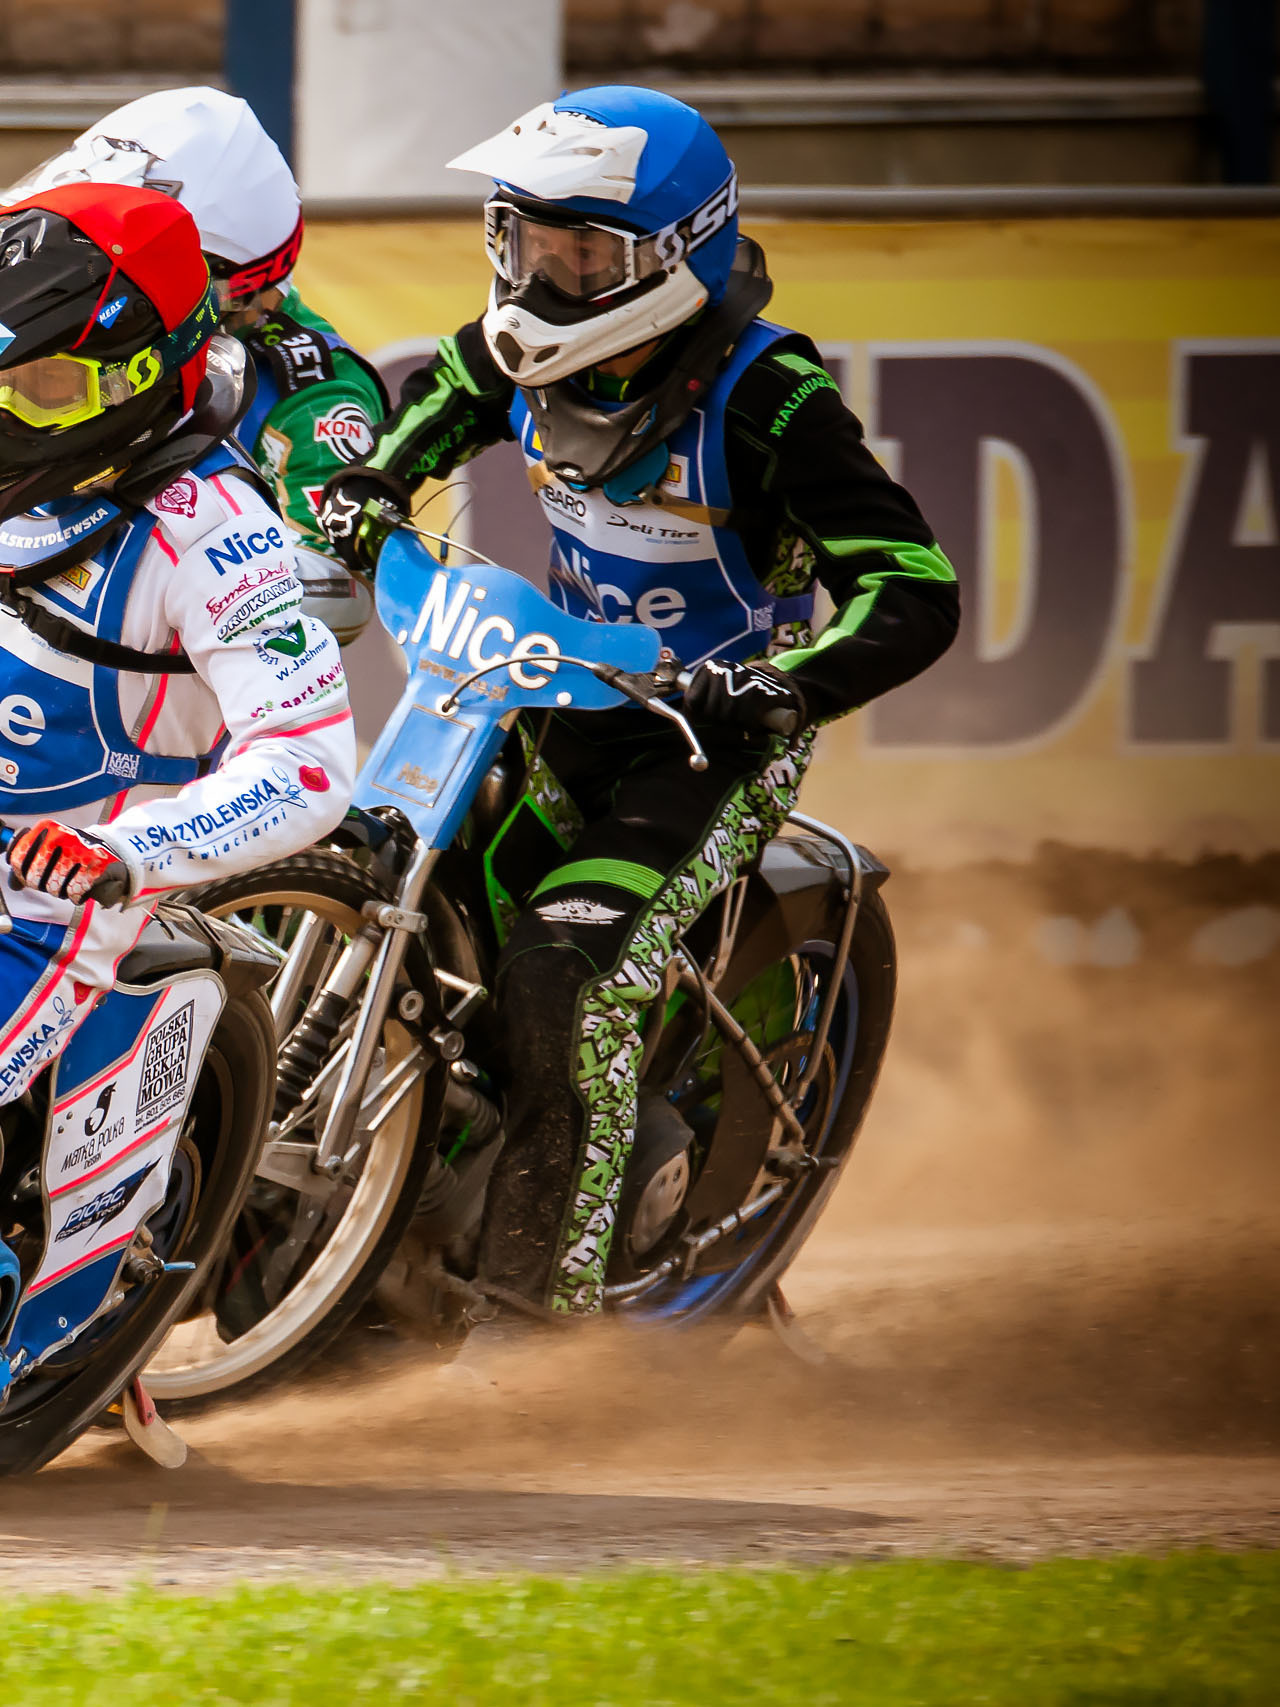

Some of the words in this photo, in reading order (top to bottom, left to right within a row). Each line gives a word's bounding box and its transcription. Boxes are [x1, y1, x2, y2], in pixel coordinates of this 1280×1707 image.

[606, 512, 654, 535] Deli
[659, 527, 700, 539] Tire
[205, 526, 284, 576] Nice
[411, 571, 561, 691] Nice
[146, 1027, 187, 1069] GRUPA
[148, 1010, 188, 1052] POLSKA
[140, 1063, 184, 1107] MOWA
[143, 1046, 186, 1087] REKLA
